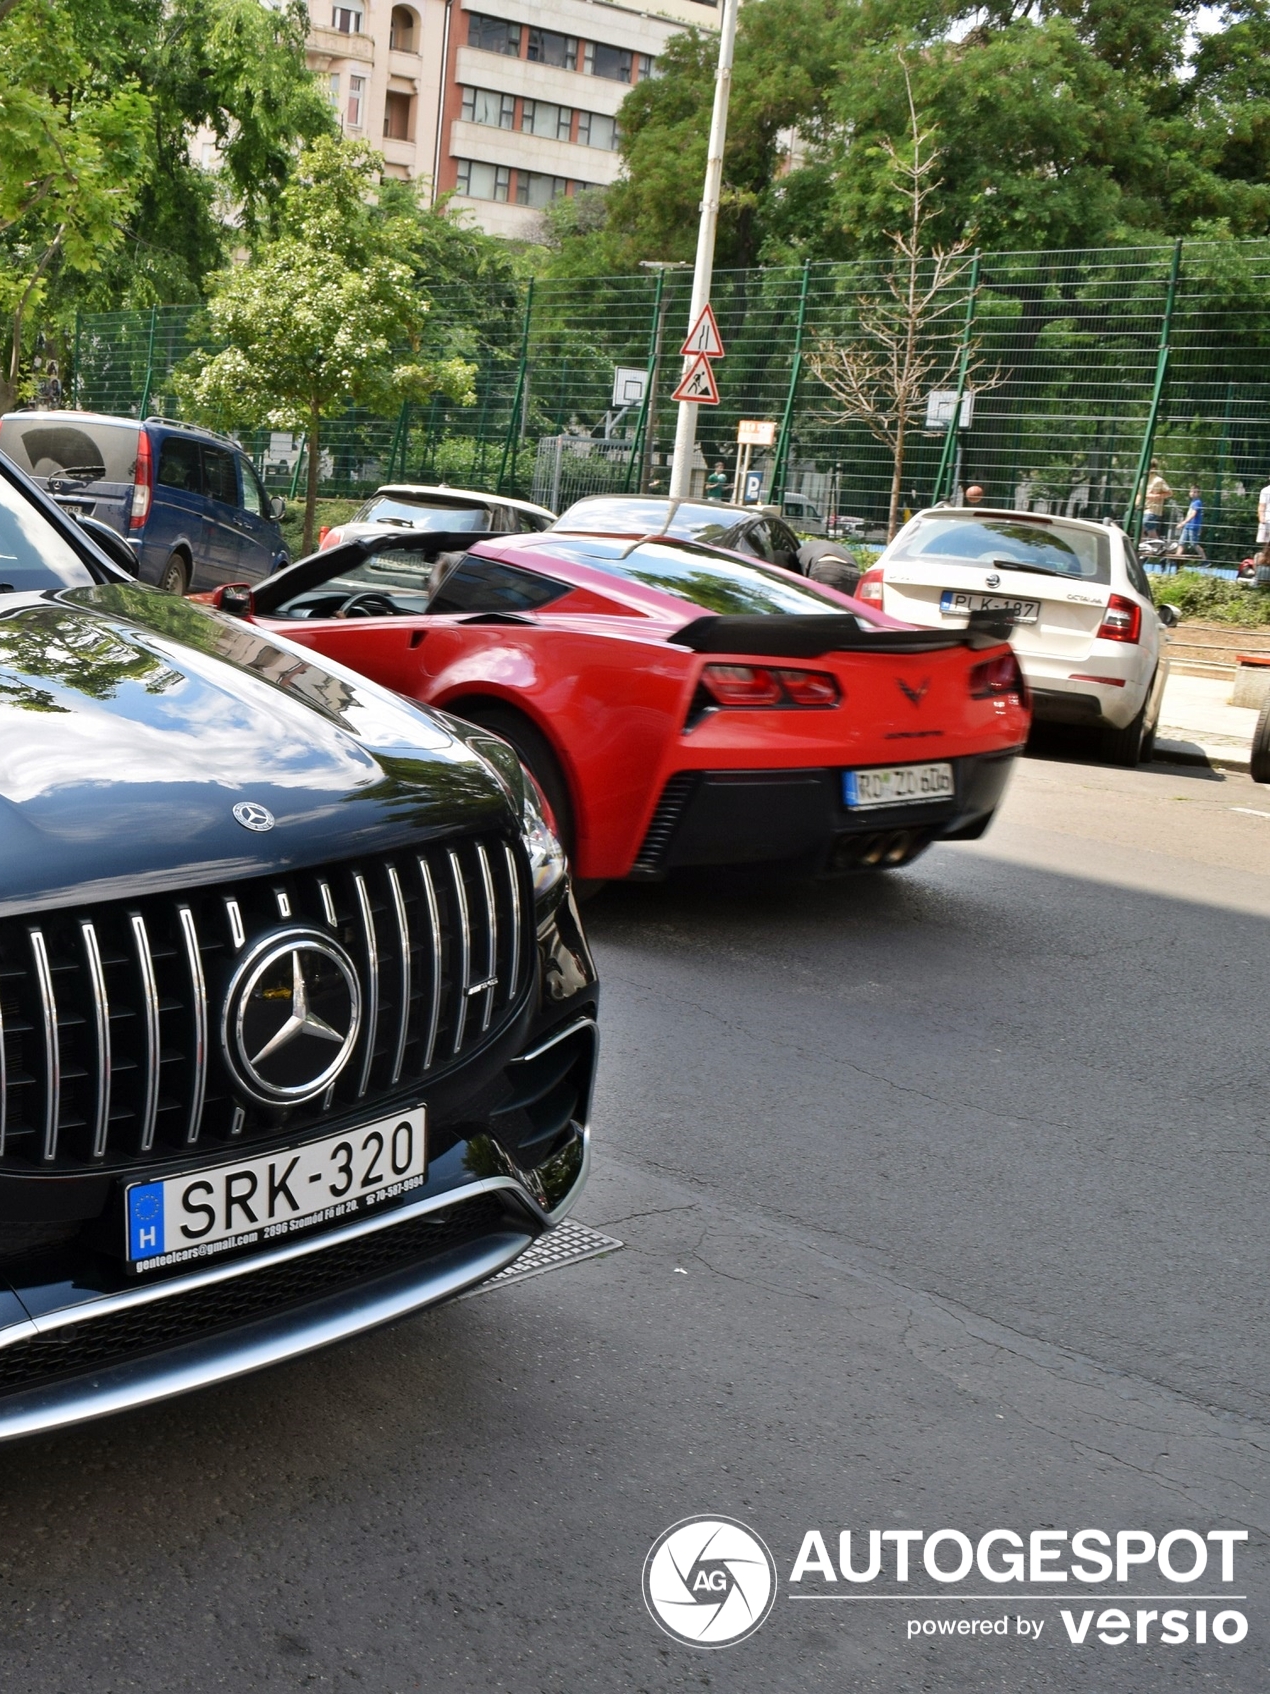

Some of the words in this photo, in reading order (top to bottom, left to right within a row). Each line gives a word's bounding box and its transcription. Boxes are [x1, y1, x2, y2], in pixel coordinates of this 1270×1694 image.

[747, 476, 760, 497] P
[180, 1121, 413, 1239] SRK-320
[136, 1231, 258, 1273] genteelcars@gmail.com
[263, 1221, 288, 1239] 2896
[289, 1210, 324, 1232] Szomód
[139, 1226, 156, 1249] H
